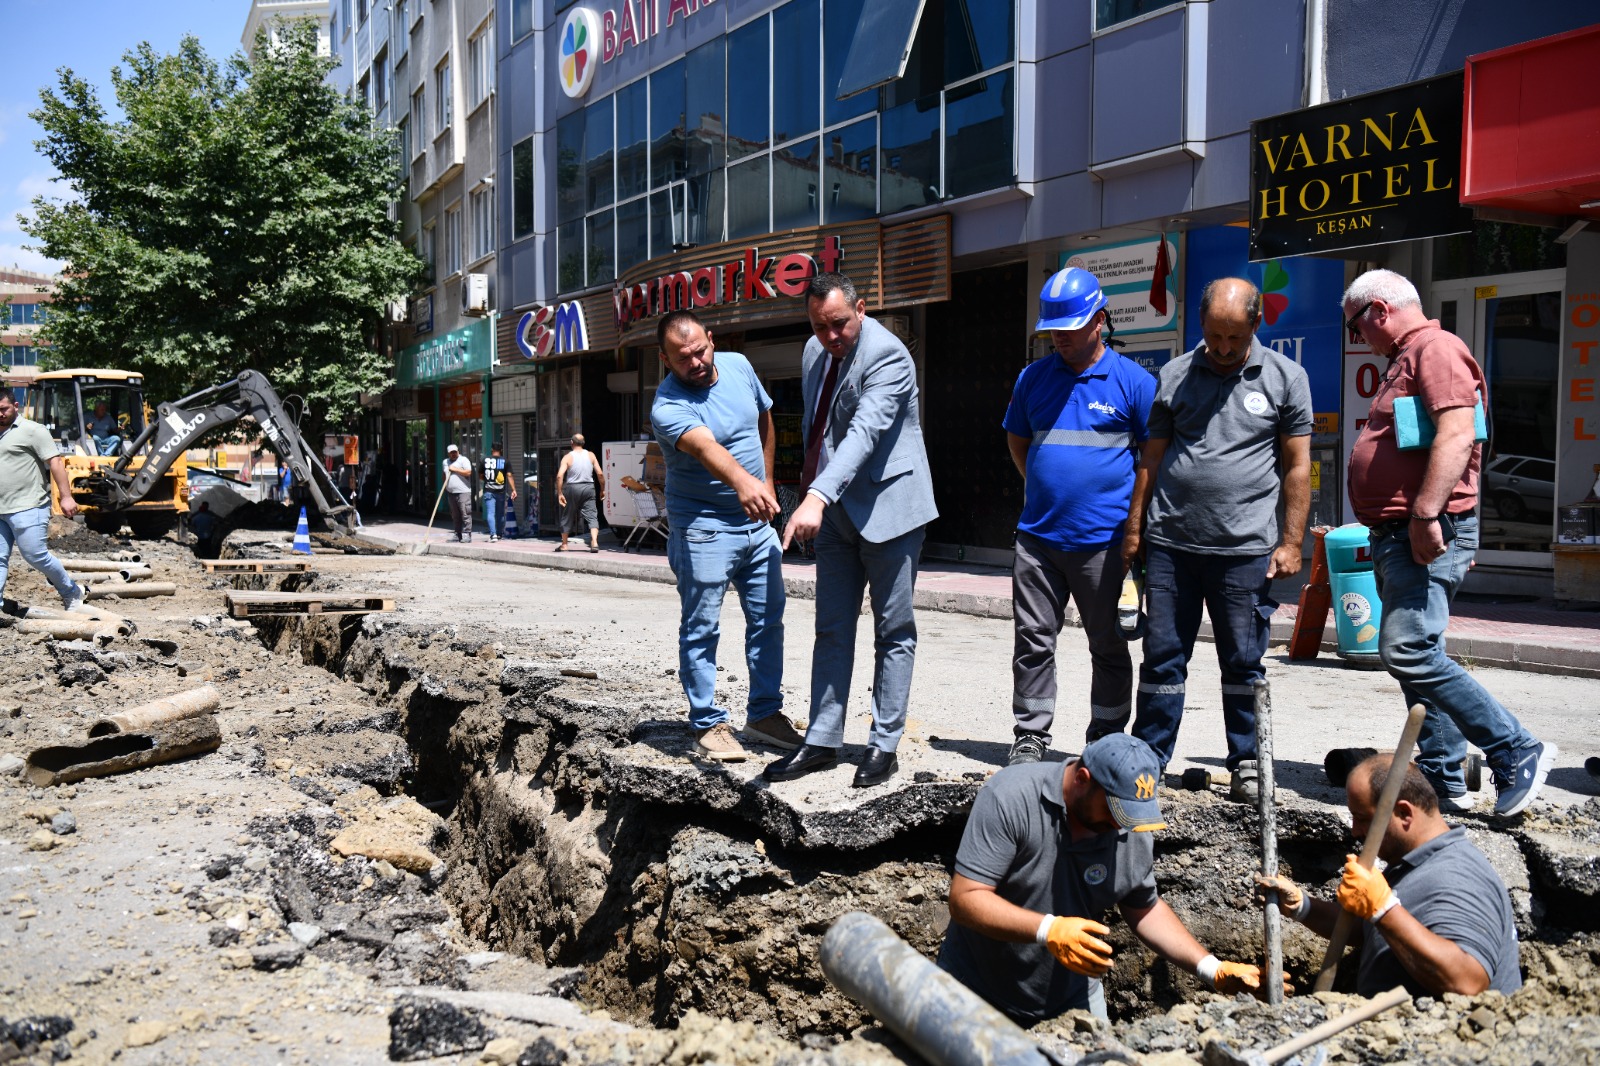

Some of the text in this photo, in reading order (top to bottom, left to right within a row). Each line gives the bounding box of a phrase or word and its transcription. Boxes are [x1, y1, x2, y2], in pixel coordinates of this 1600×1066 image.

[1259, 107, 1438, 174] VARNA
[1258, 158, 1453, 220] HOTEL
[1316, 214, 1373, 236] KEŞAN
[1123, 258, 1144, 267] AKADEMİ
[1124, 304, 1147, 314] AKADEMİ
[158, 412, 206, 454] VOLVO
[1134, 772, 1156, 800] NY
